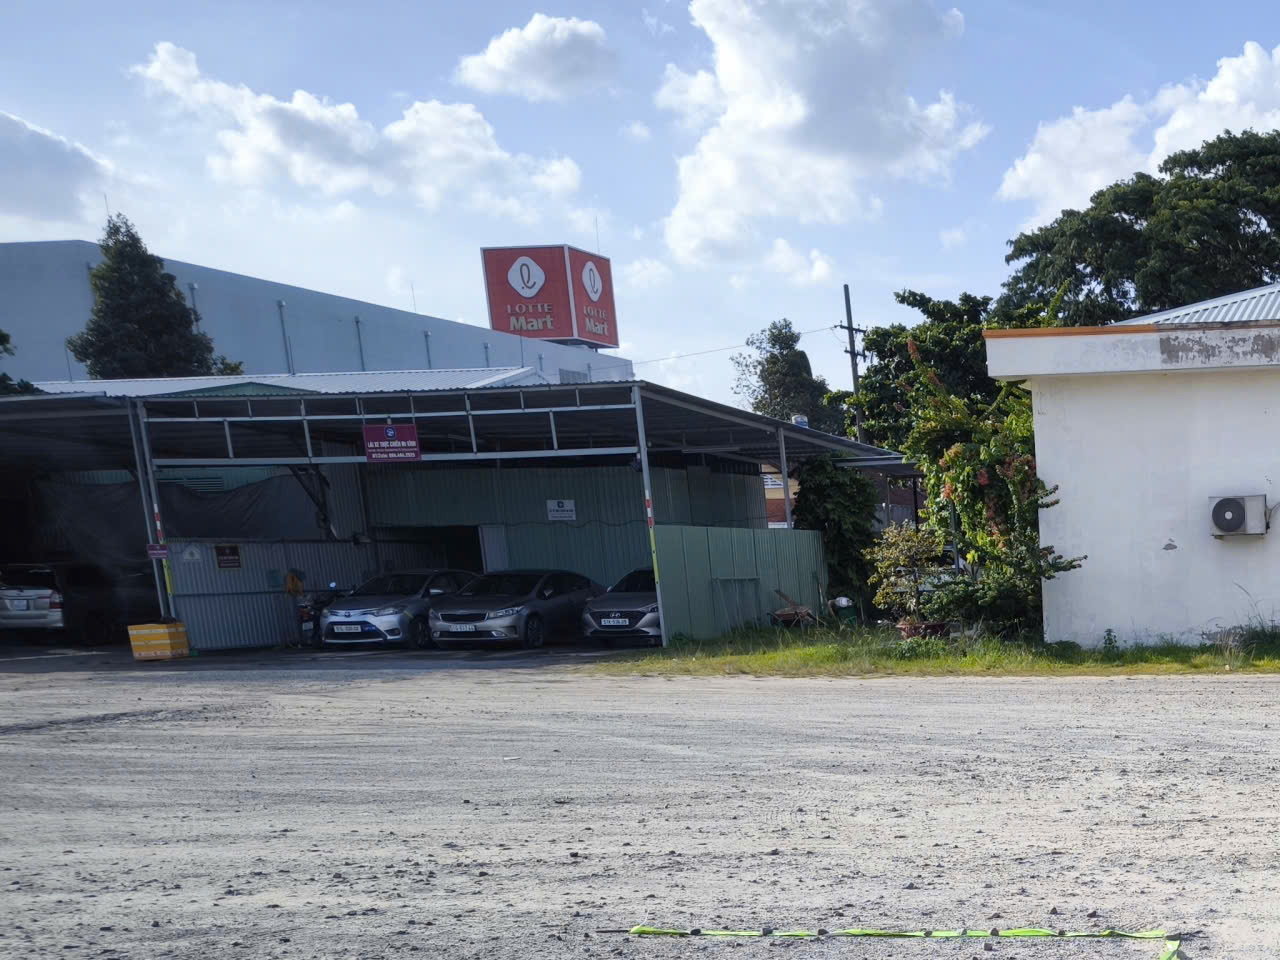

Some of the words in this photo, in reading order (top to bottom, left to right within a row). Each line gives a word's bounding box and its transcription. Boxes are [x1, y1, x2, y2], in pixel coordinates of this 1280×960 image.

[506, 303, 553, 314] LOTTE
[509, 314, 554, 331] Mart
[585, 317, 609, 336] Mart
